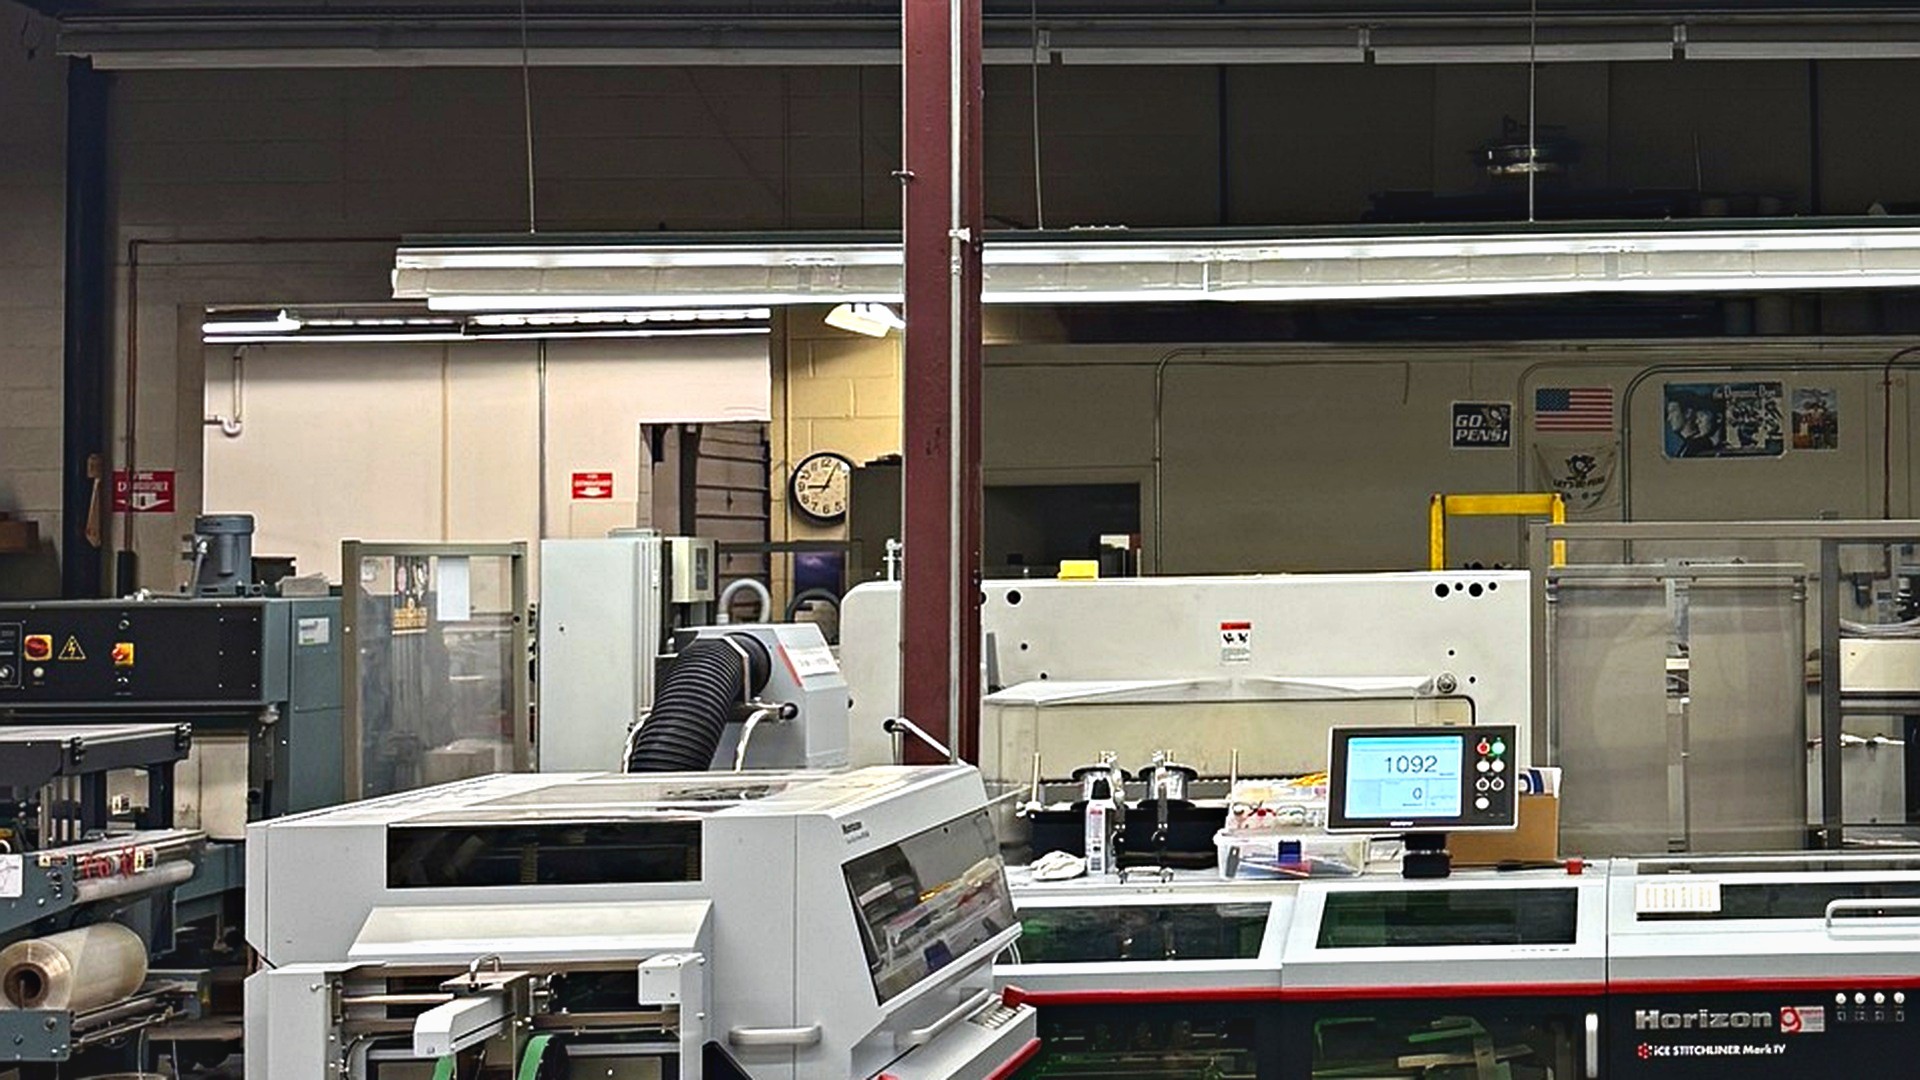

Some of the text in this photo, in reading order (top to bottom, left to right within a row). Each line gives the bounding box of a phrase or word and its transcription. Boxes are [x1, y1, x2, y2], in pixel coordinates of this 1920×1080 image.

[1456, 429, 1507, 441] PENS!
[1385, 755, 1437, 773] 1092
[1412, 787, 1422, 799] 0
[1635, 1009, 1772, 1030] Horizon
[1673, 1044, 1740, 1056] STITCHLINER
[1743, 1044, 1771, 1055] Mark
